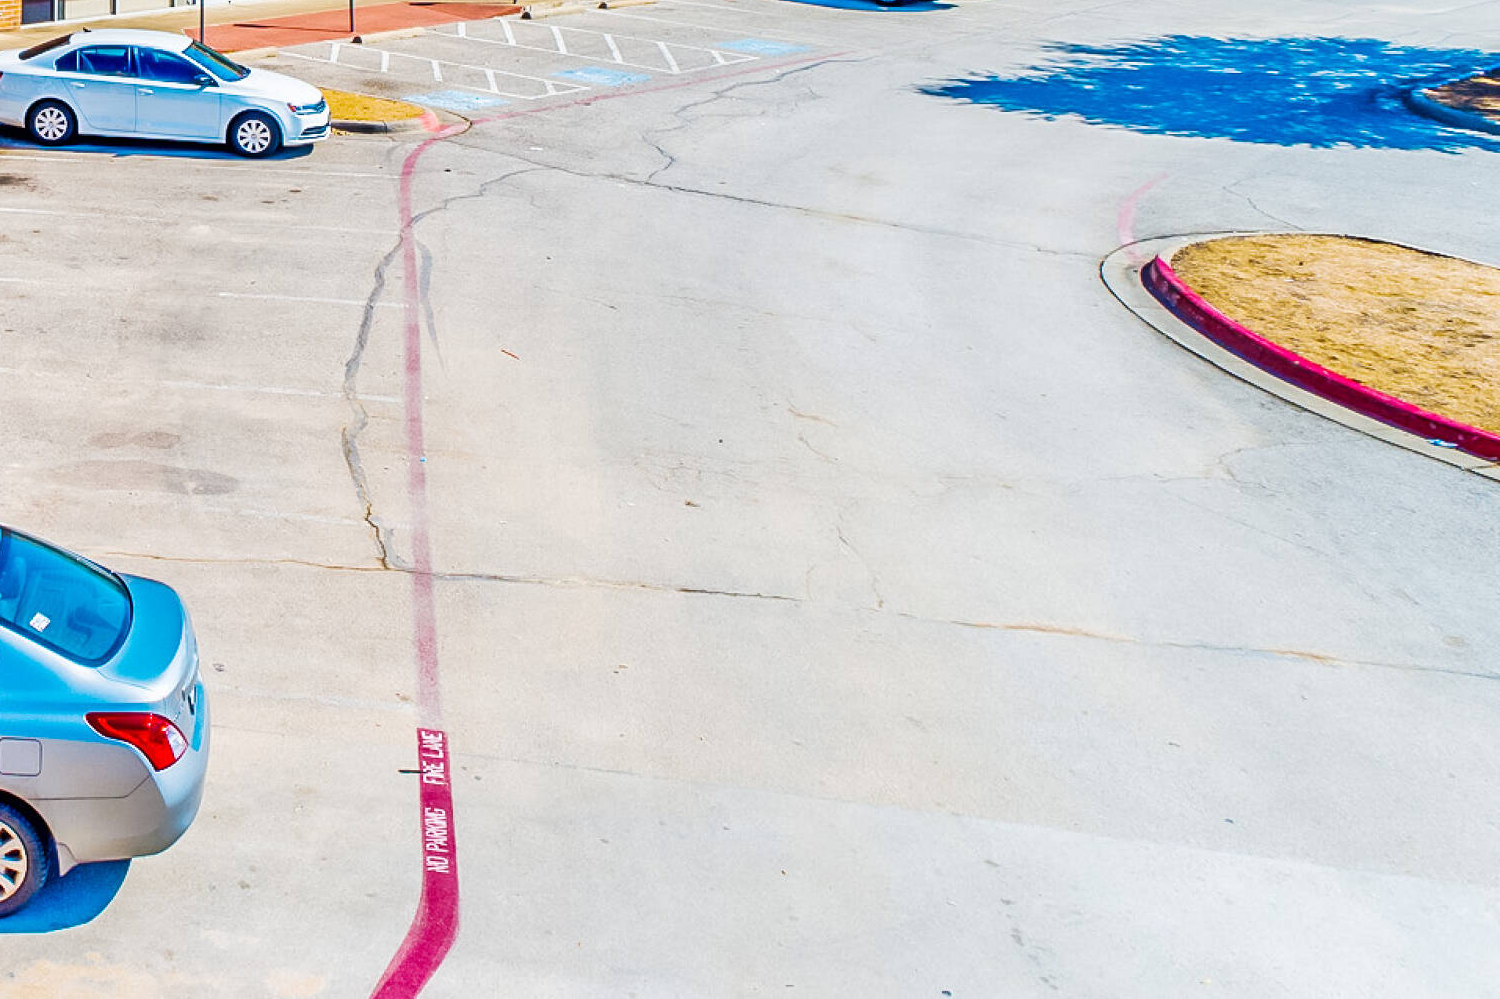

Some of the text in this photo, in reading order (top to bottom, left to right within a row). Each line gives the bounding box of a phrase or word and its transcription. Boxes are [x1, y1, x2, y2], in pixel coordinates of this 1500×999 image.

[421, 730, 449, 874] NO PARKING FIRE LANE
